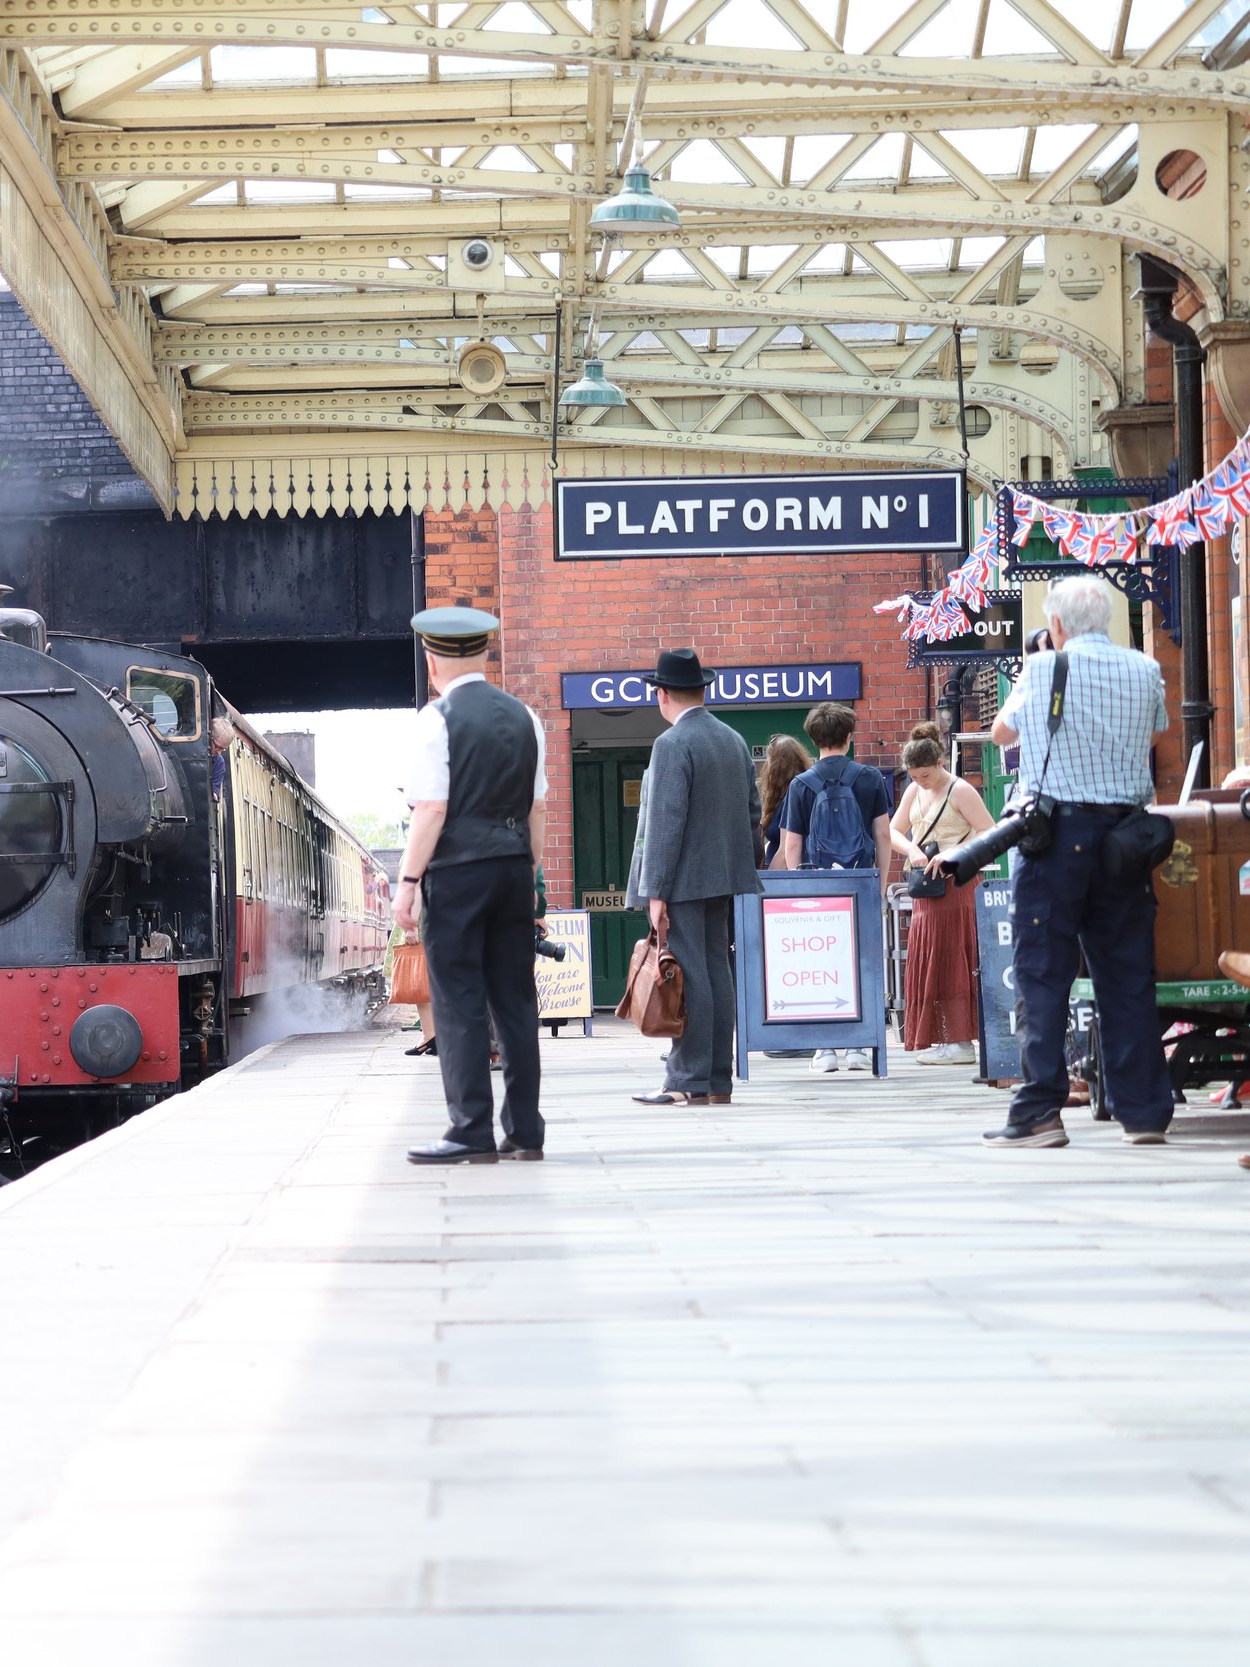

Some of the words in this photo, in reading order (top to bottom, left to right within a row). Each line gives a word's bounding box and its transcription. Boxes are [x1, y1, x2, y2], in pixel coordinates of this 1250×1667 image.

[585, 495, 842, 535] PLATFORM
[973, 620, 1014, 637] OUT
[774, 915, 814, 924] SOUVENIR
[824, 914, 840, 922] GIFT
[781, 935, 837, 953] SHOP
[557, 968, 580, 980] are
[781, 970, 839, 987] OPEN
[538, 982, 586, 998] Welcome
[1181, 986, 1210, 998] TARE
[541, 996, 582, 1012] Browse
